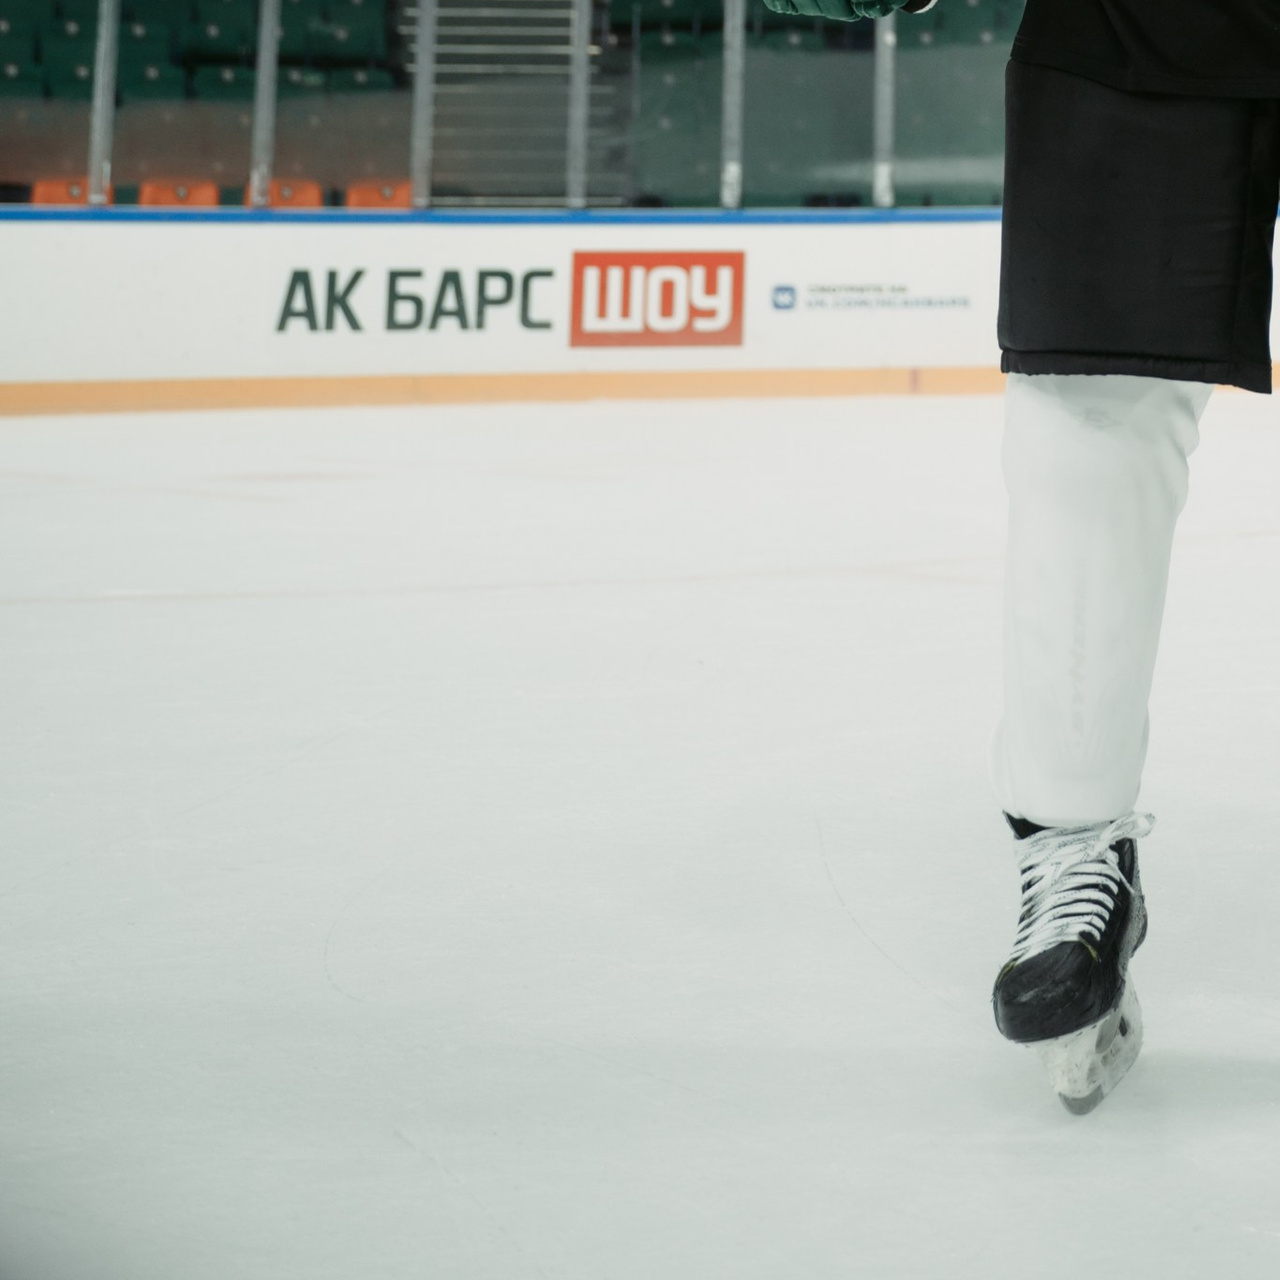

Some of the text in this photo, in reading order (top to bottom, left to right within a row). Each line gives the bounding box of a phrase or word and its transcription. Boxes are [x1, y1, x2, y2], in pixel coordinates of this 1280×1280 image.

[276, 265, 734, 333] АК БАРС ШОУ
